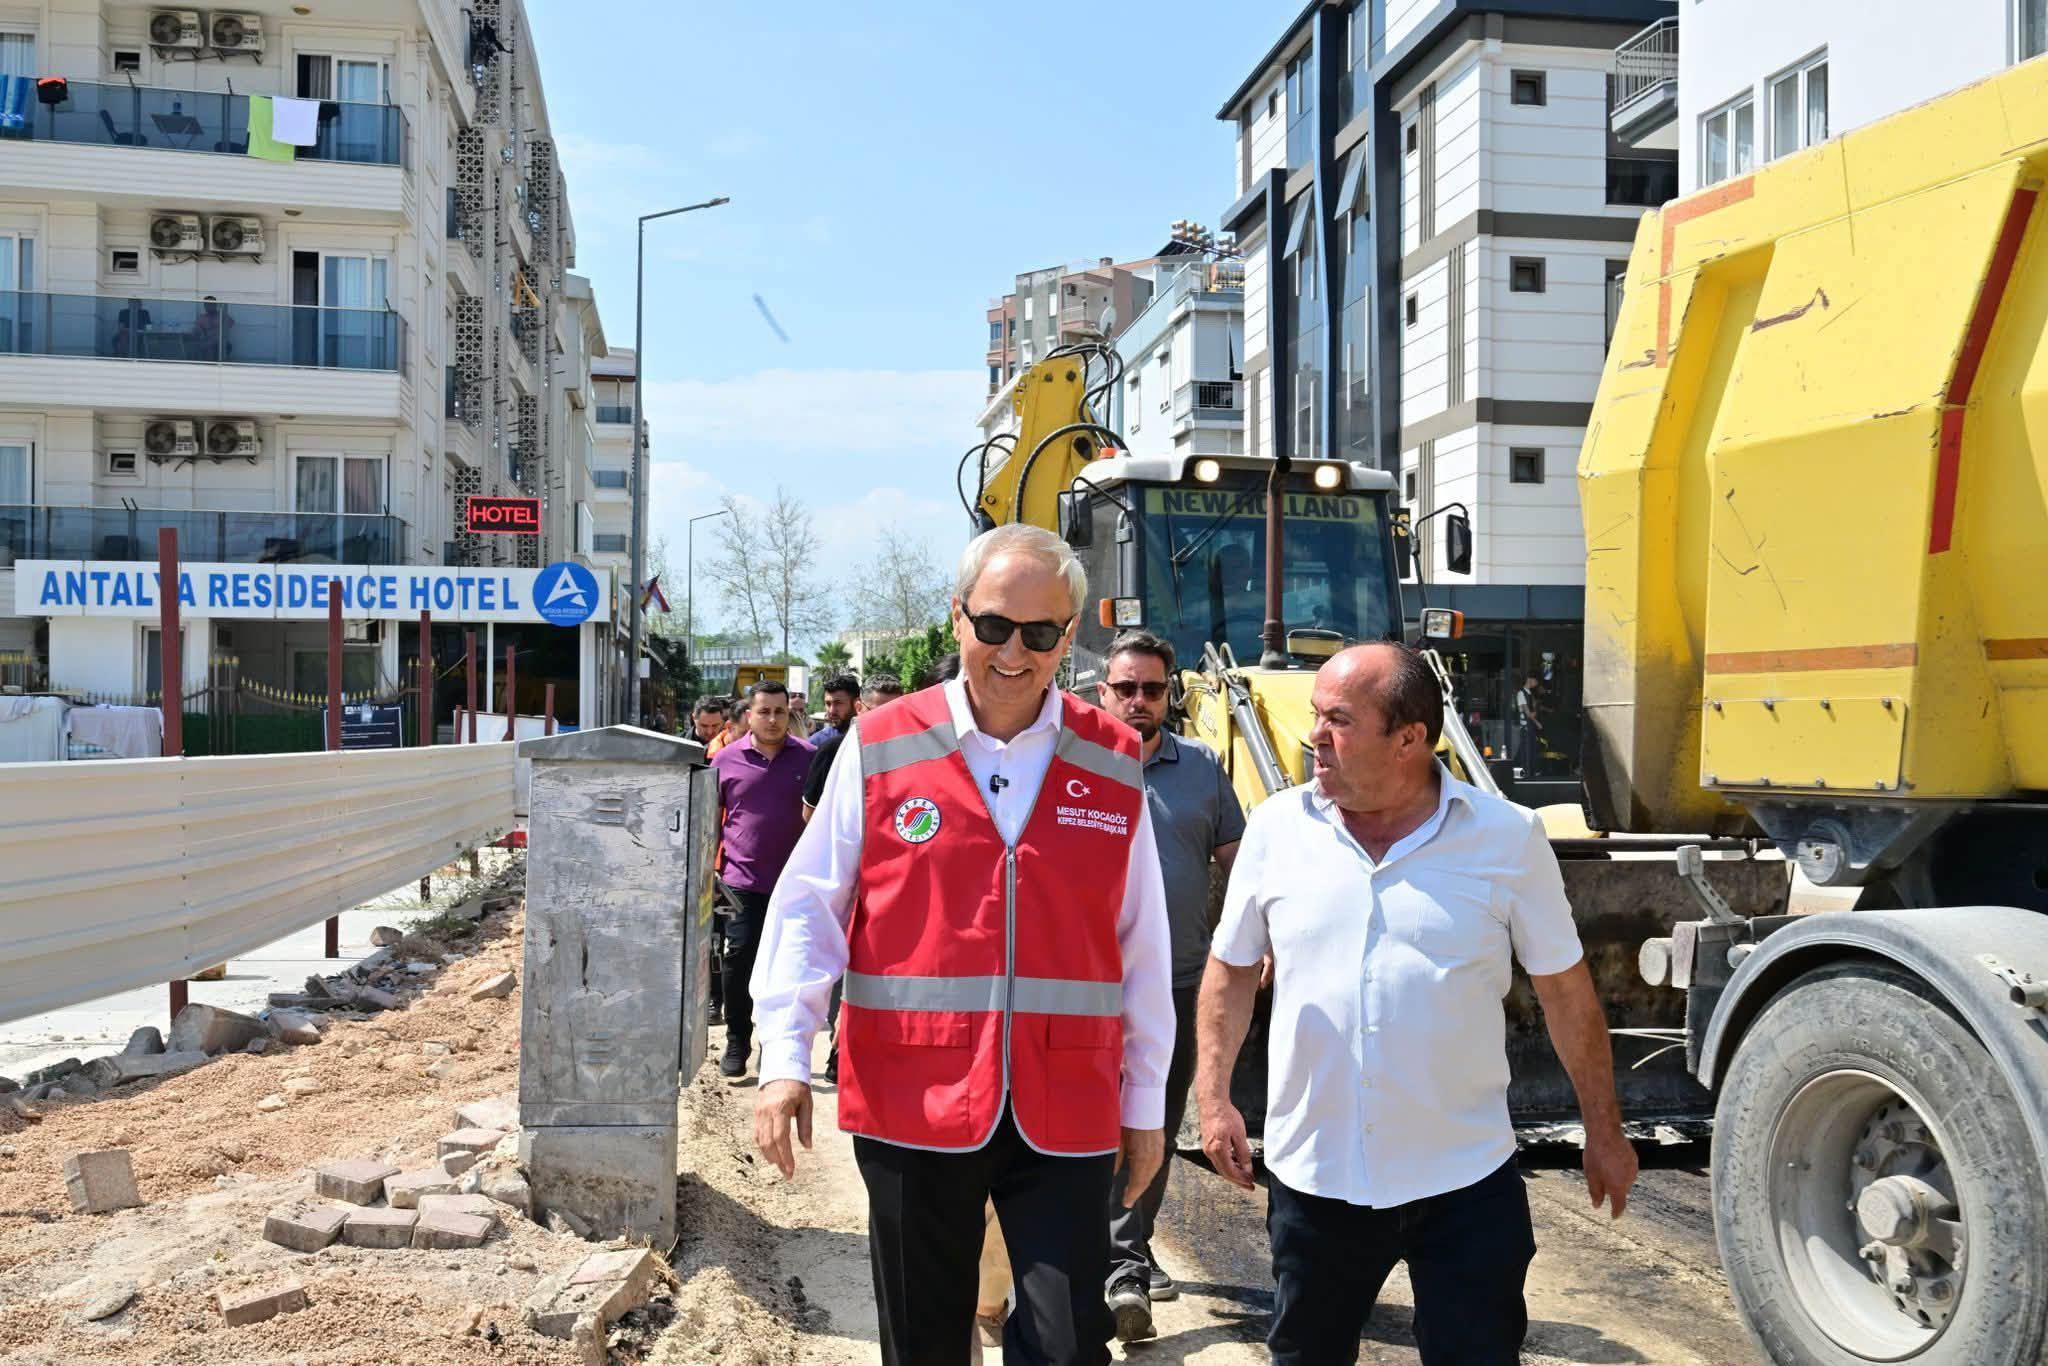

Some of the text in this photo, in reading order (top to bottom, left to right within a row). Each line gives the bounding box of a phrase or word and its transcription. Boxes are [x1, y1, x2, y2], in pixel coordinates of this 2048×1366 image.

[472, 506, 537, 524] HOTEL
[1163, 490, 1360, 519] NEW HOLAND
[208, 573, 397, 609] RESIDENCE
[410, 576, 519, 610] HOTEL
[1056, 806, 1128, 825] MESUT KOCAGÖZ
